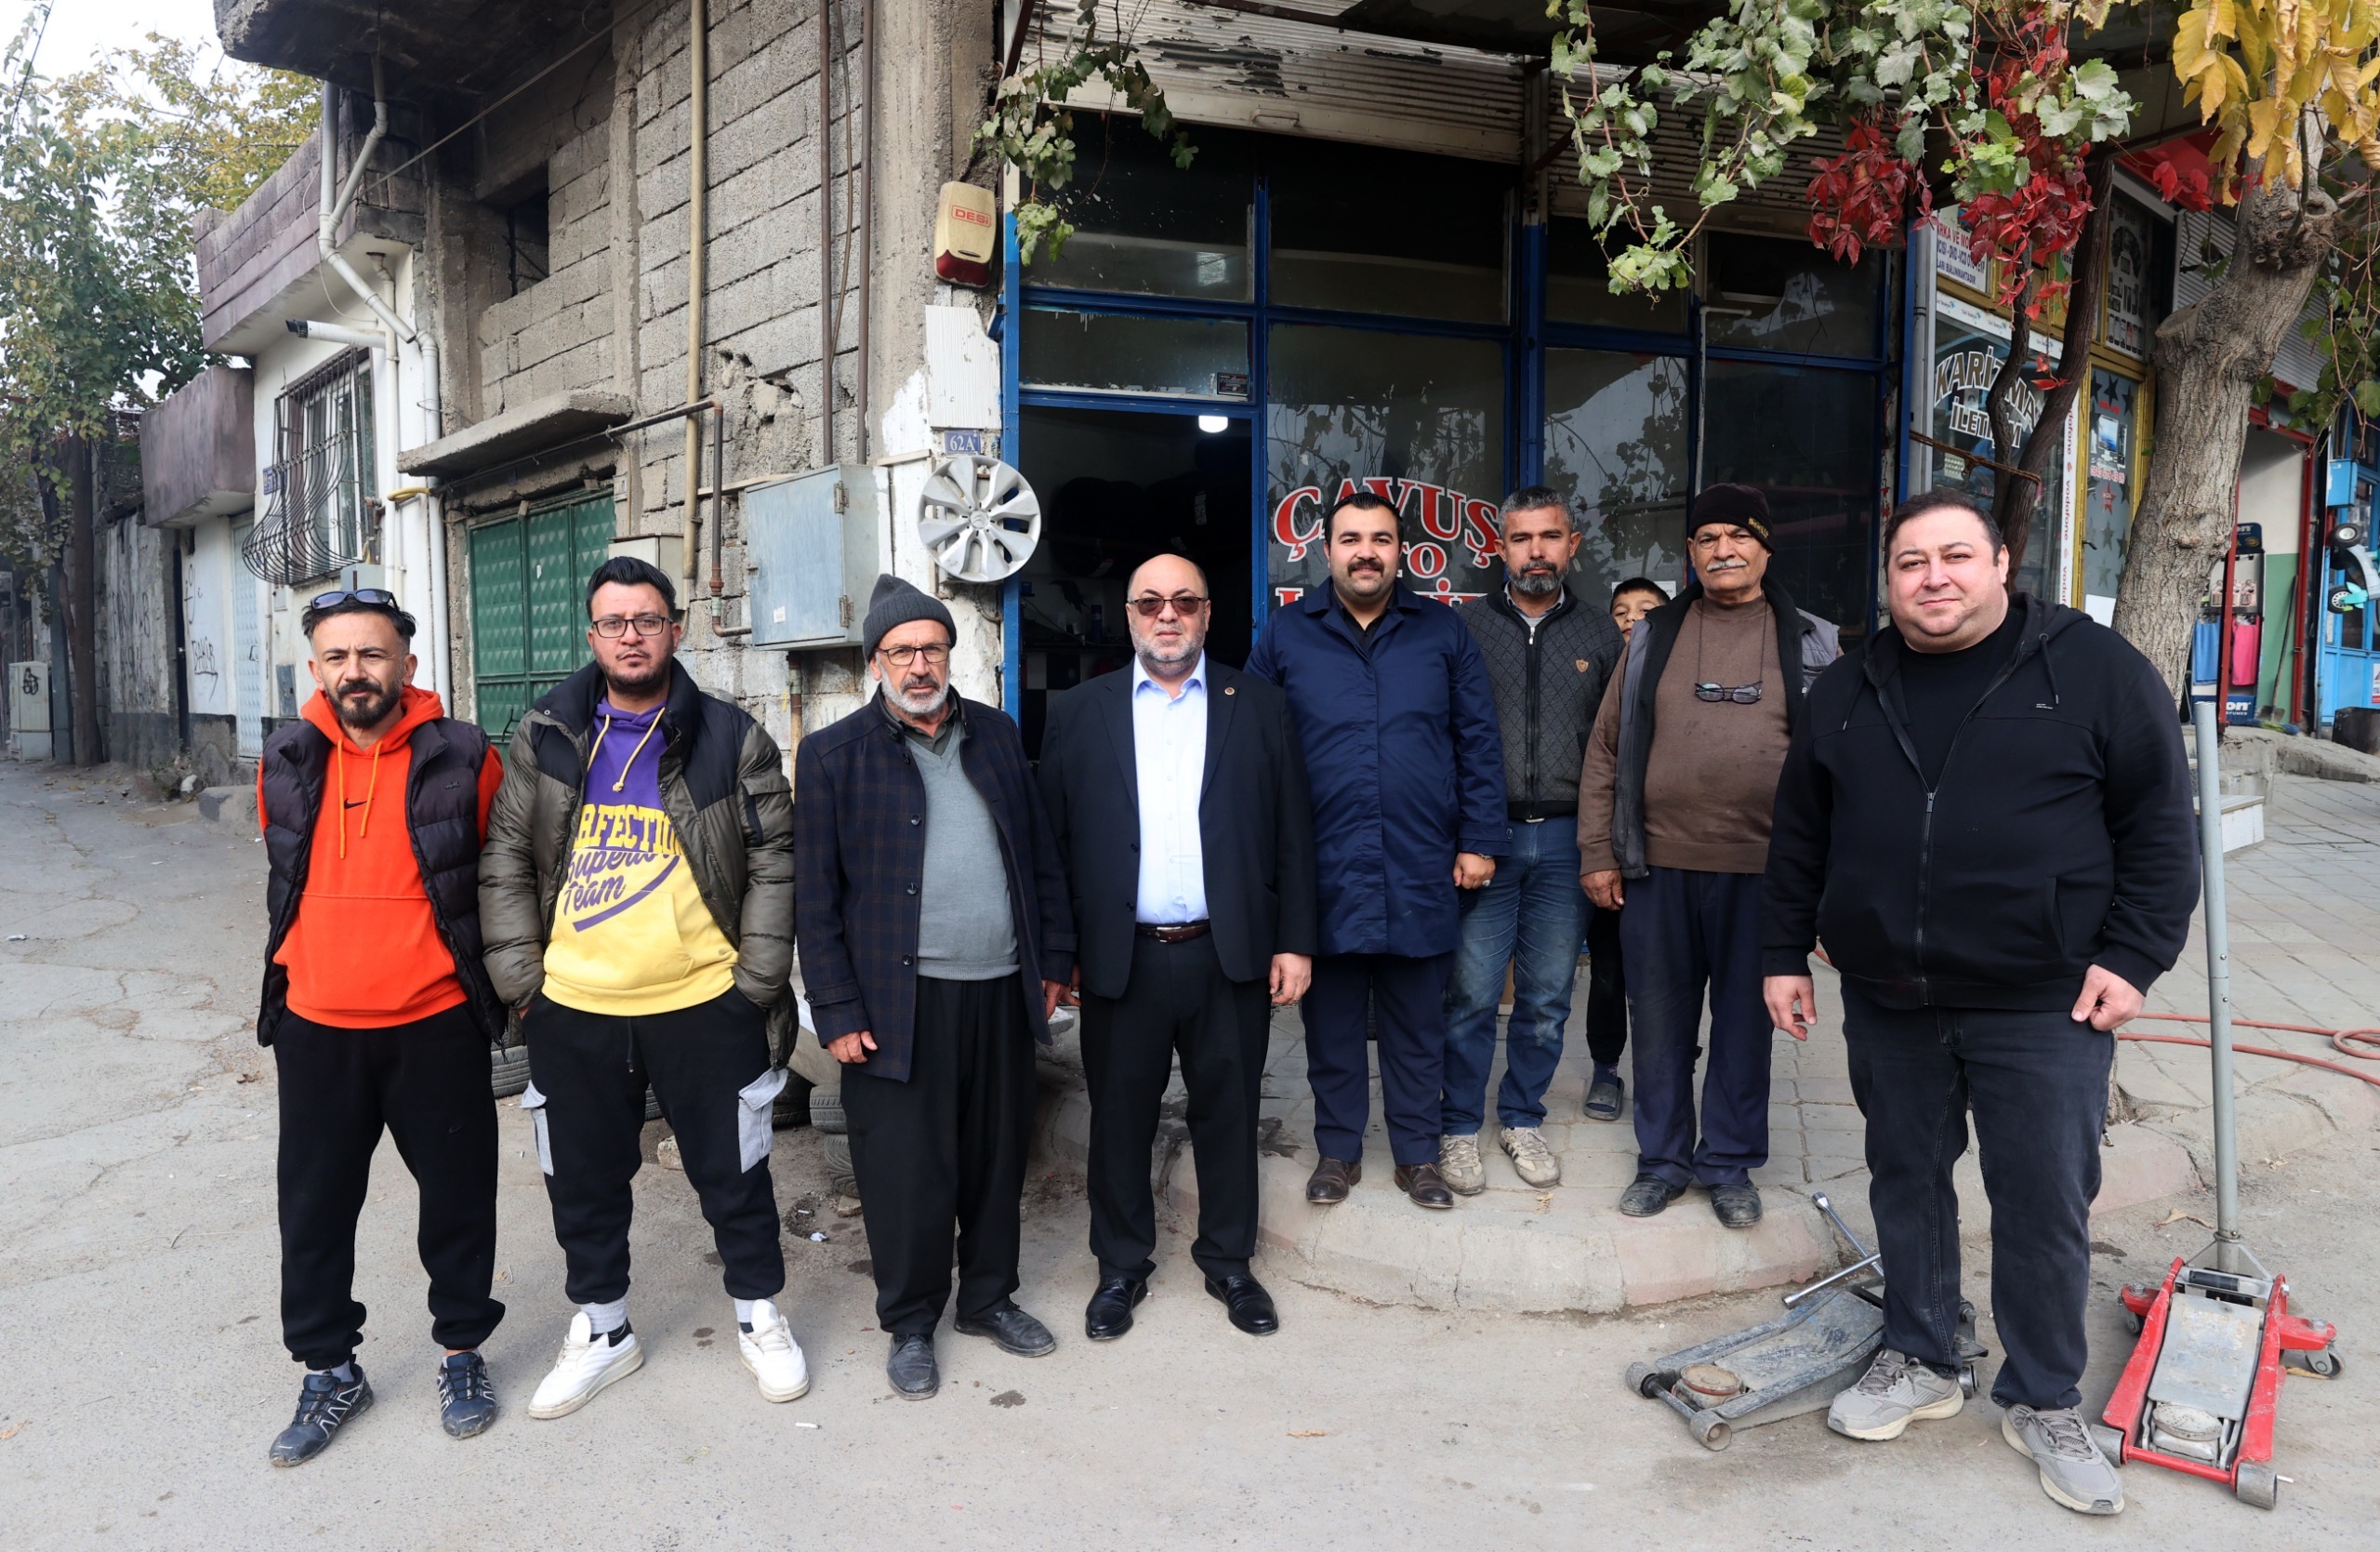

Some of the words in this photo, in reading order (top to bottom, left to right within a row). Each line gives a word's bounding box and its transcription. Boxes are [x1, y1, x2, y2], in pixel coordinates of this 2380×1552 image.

[949, 434, 976, 451] 62A
[573, 803, 684, 856] RFECTIO
[563, 875, 627, 916] Team
